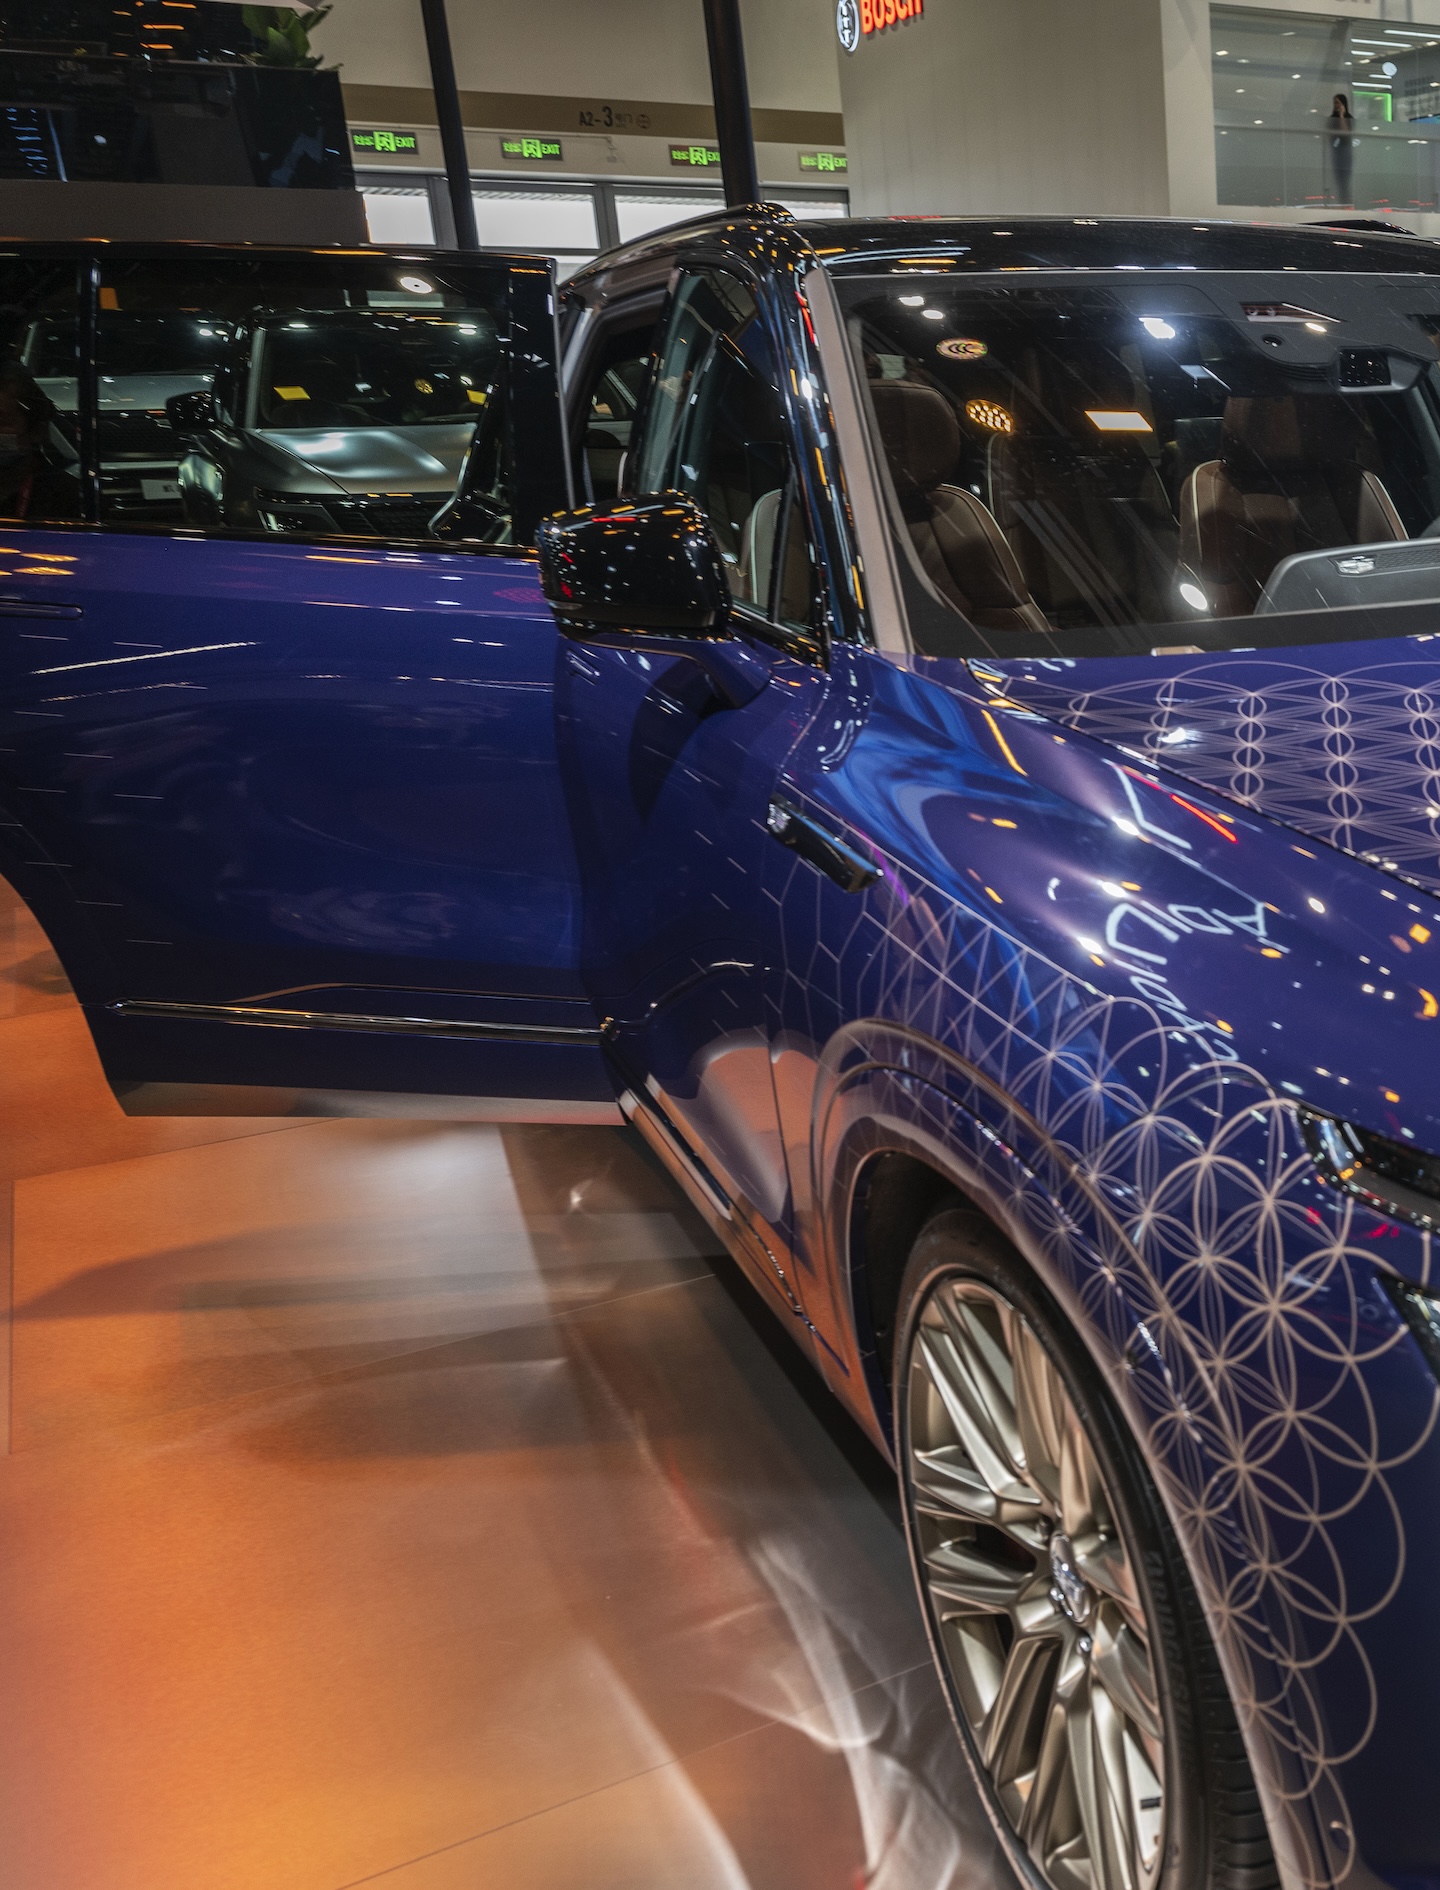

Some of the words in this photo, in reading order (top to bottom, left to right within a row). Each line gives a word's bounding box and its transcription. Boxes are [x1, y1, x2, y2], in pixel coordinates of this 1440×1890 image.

[394, 136, 416, 149] EXIT
[540, 143, 561, 155] EXIT
[707, 151, 721, 162] EXI
